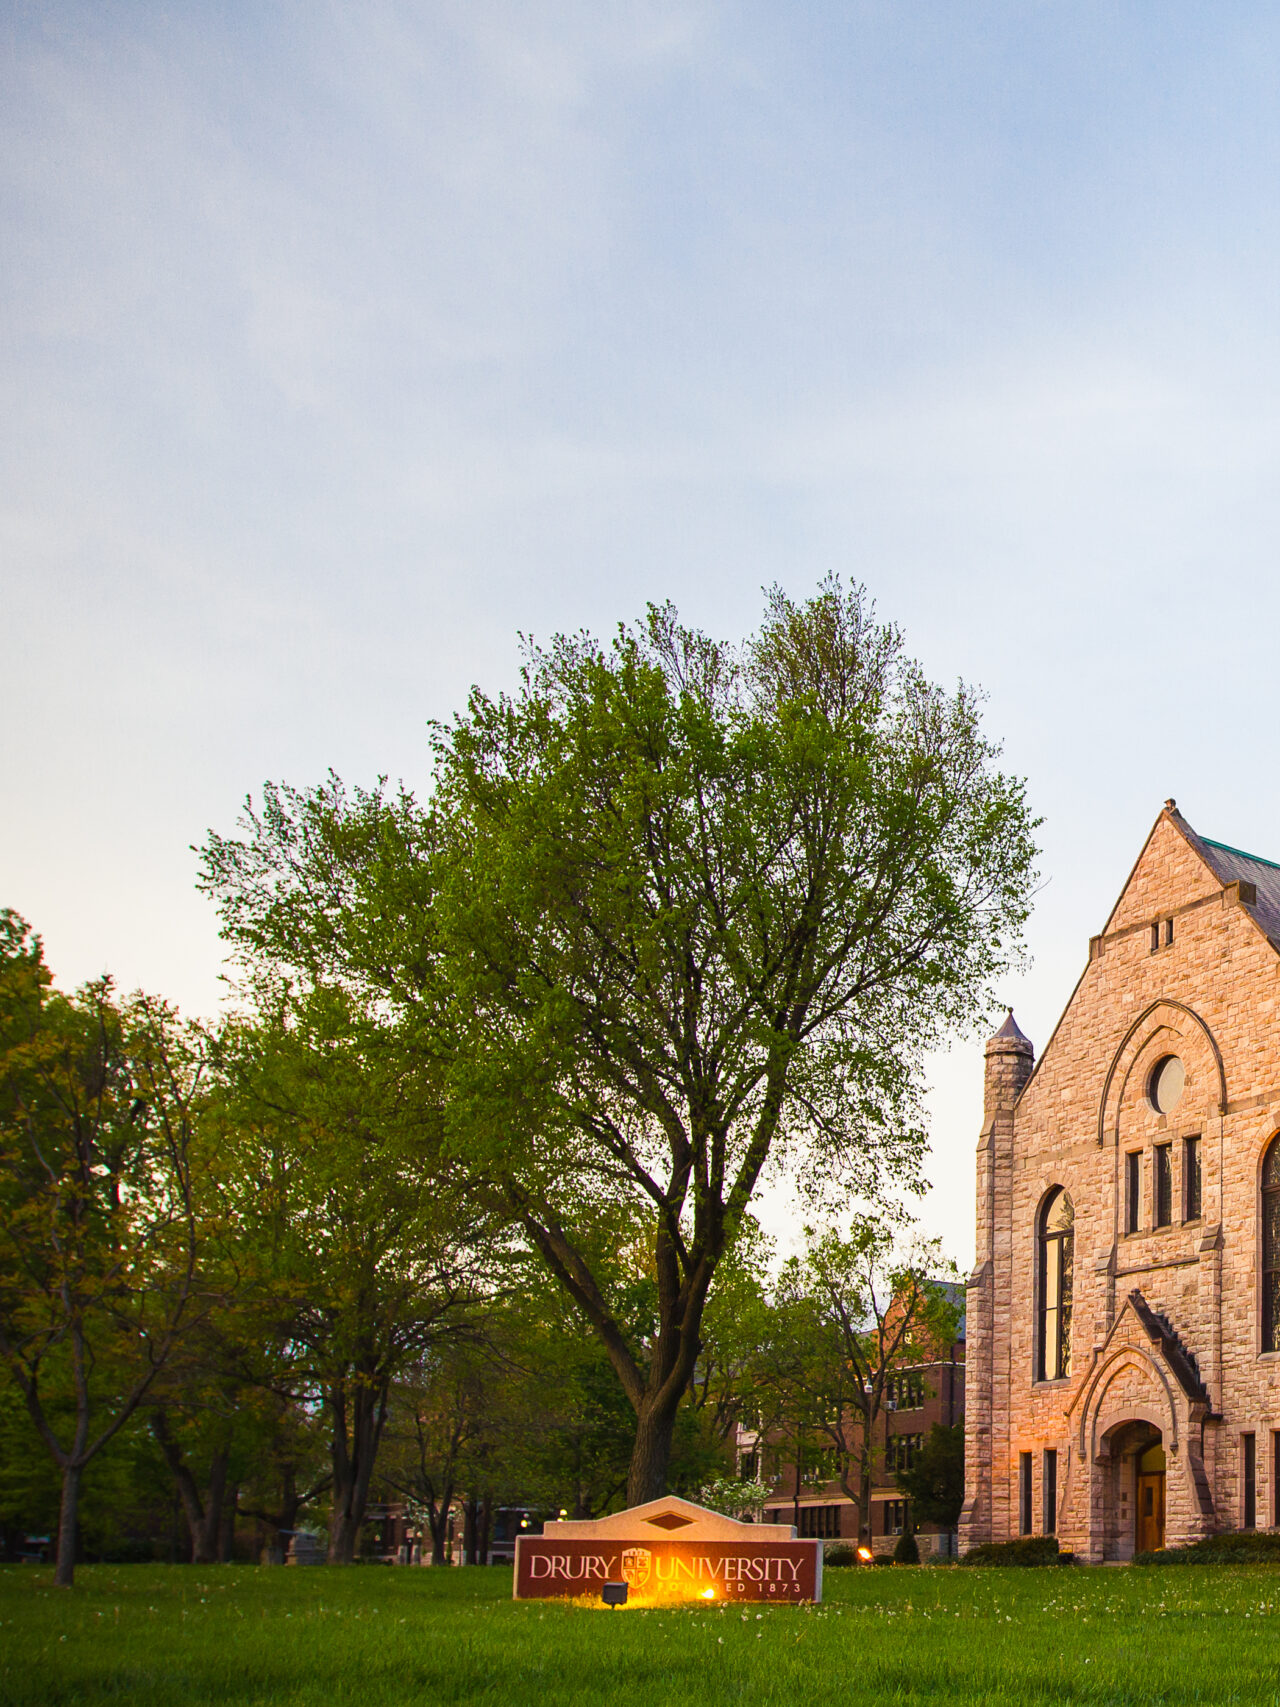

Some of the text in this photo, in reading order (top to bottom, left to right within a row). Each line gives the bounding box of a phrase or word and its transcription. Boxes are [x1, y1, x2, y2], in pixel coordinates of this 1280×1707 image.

[529, 1555, 805, 1581] DRURY UNIVERSITY
[657, 1582, 801, 1593] FOUDED 1873
